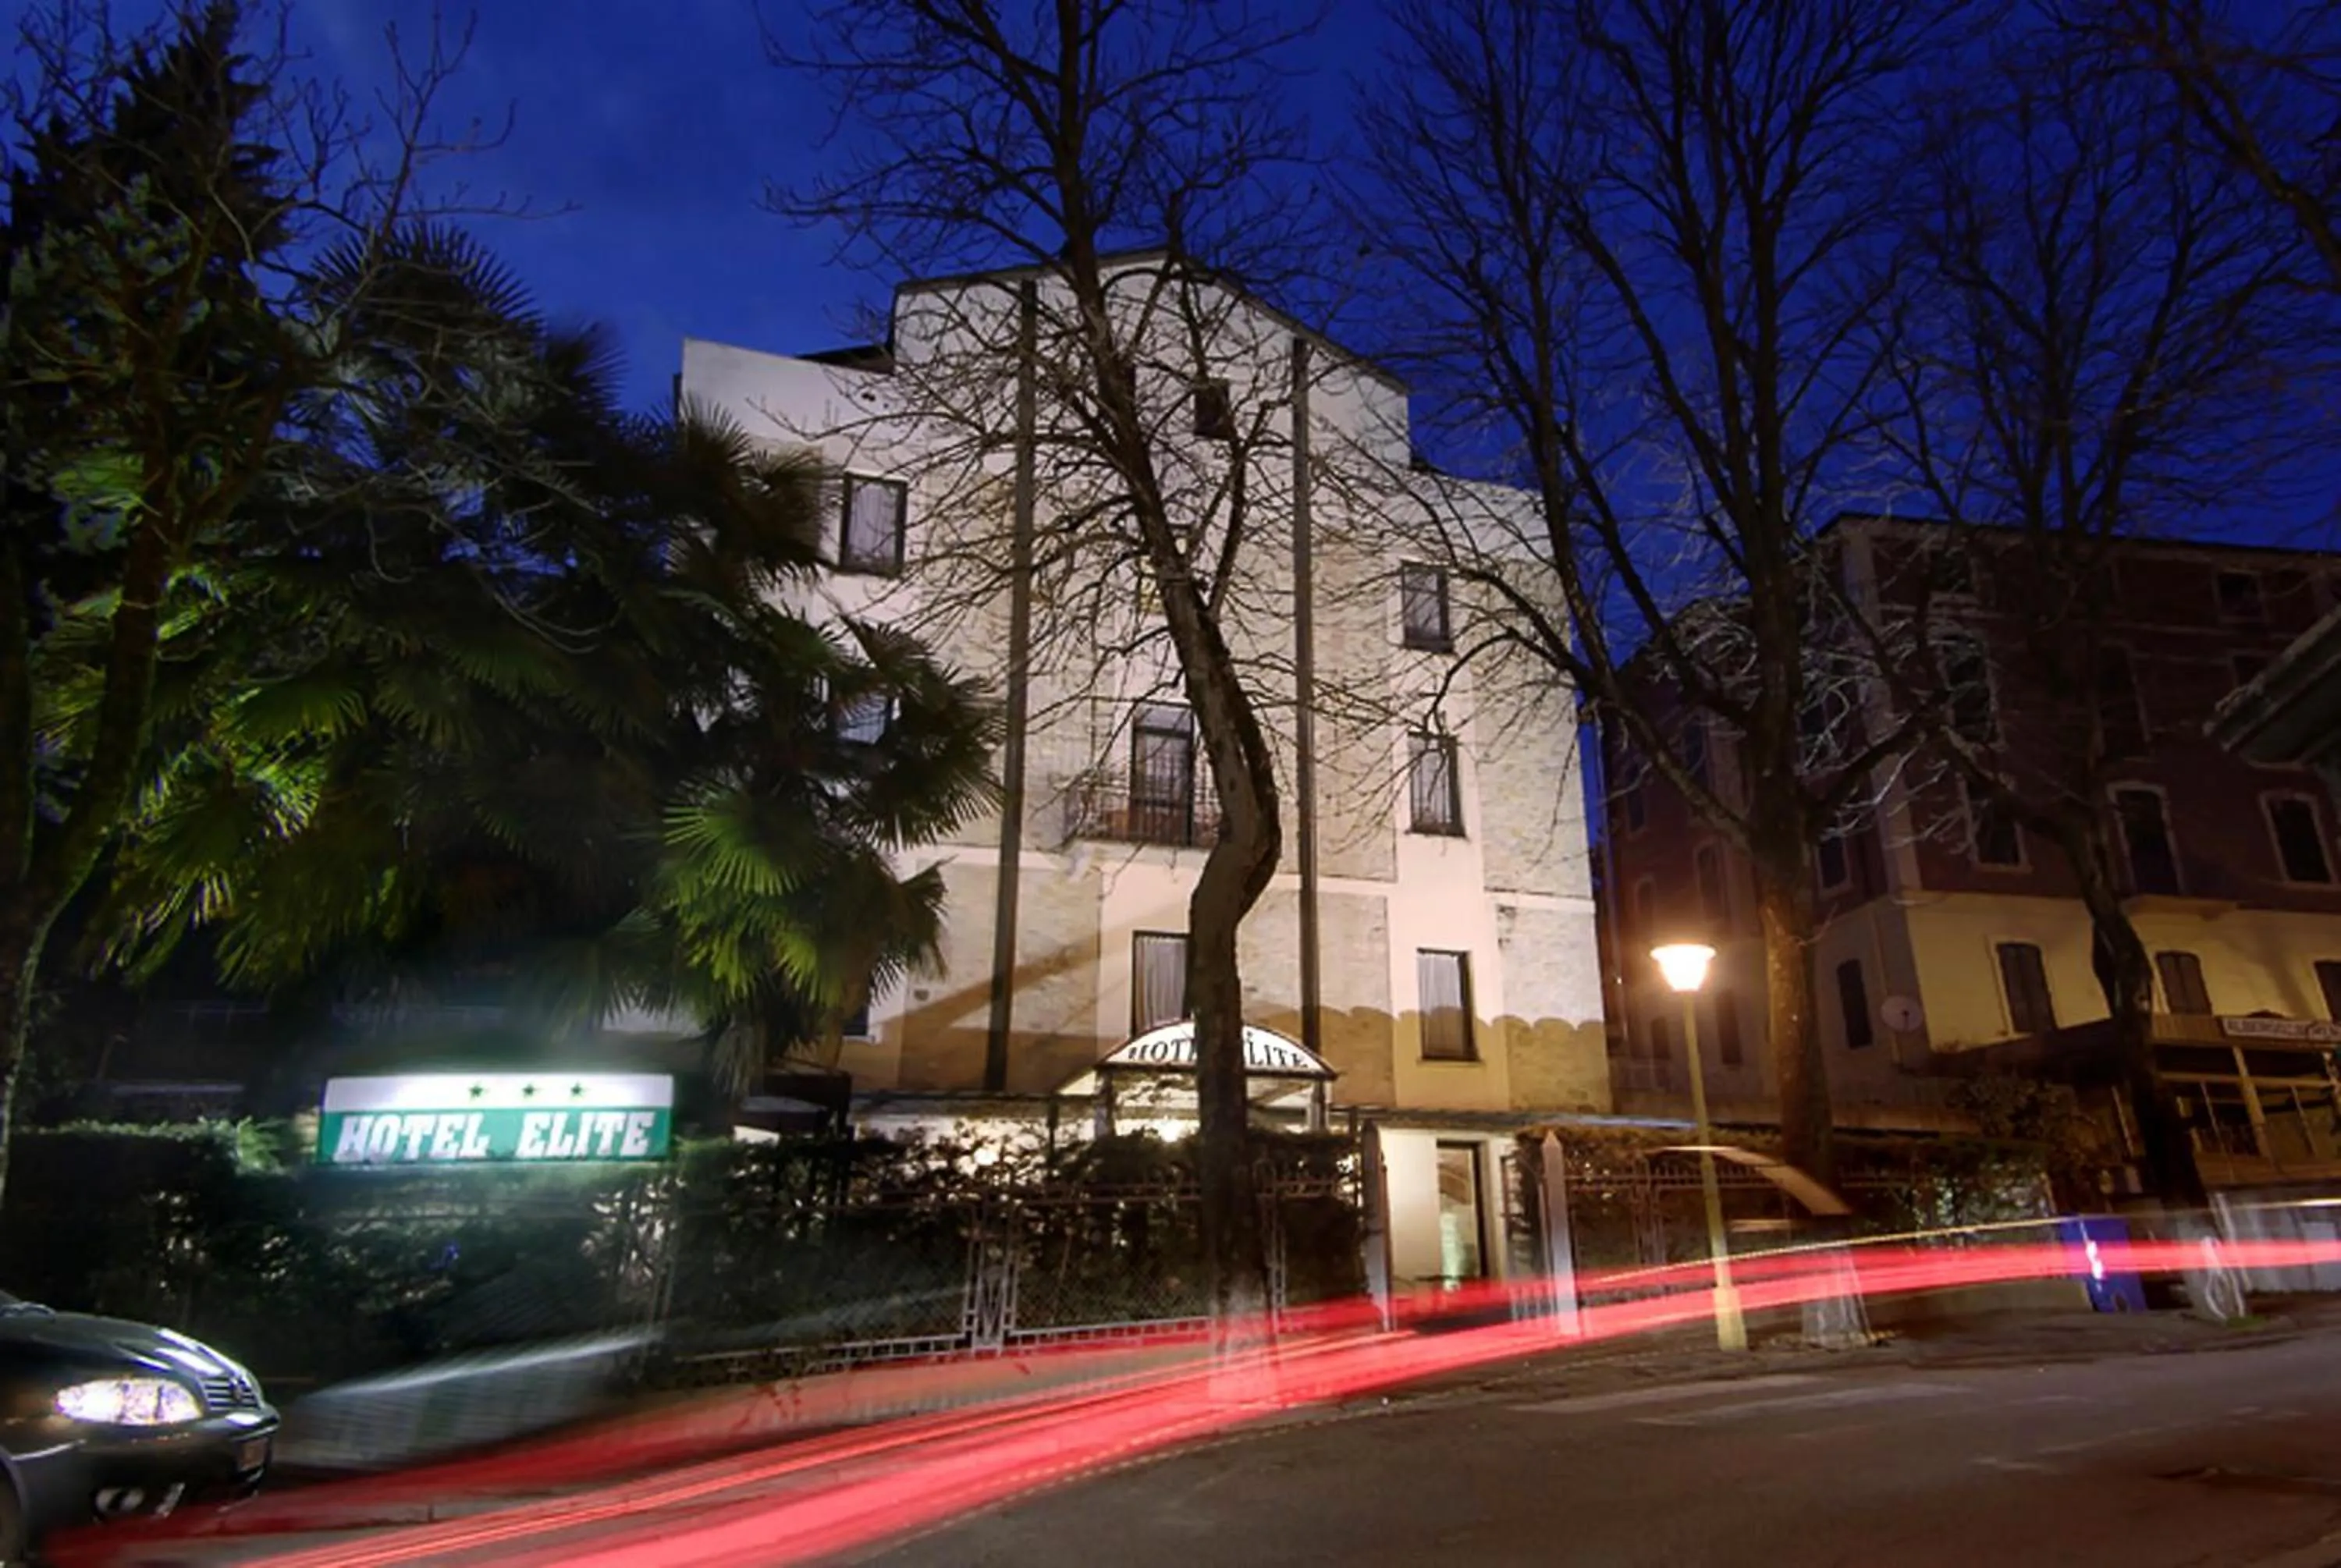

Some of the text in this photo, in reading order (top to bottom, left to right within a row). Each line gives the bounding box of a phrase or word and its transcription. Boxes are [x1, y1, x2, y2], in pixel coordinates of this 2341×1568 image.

[1128, 1037, 1308, 1069] HOT LITE
[332, 1110, 653, 1162] HOTEL ELITE
